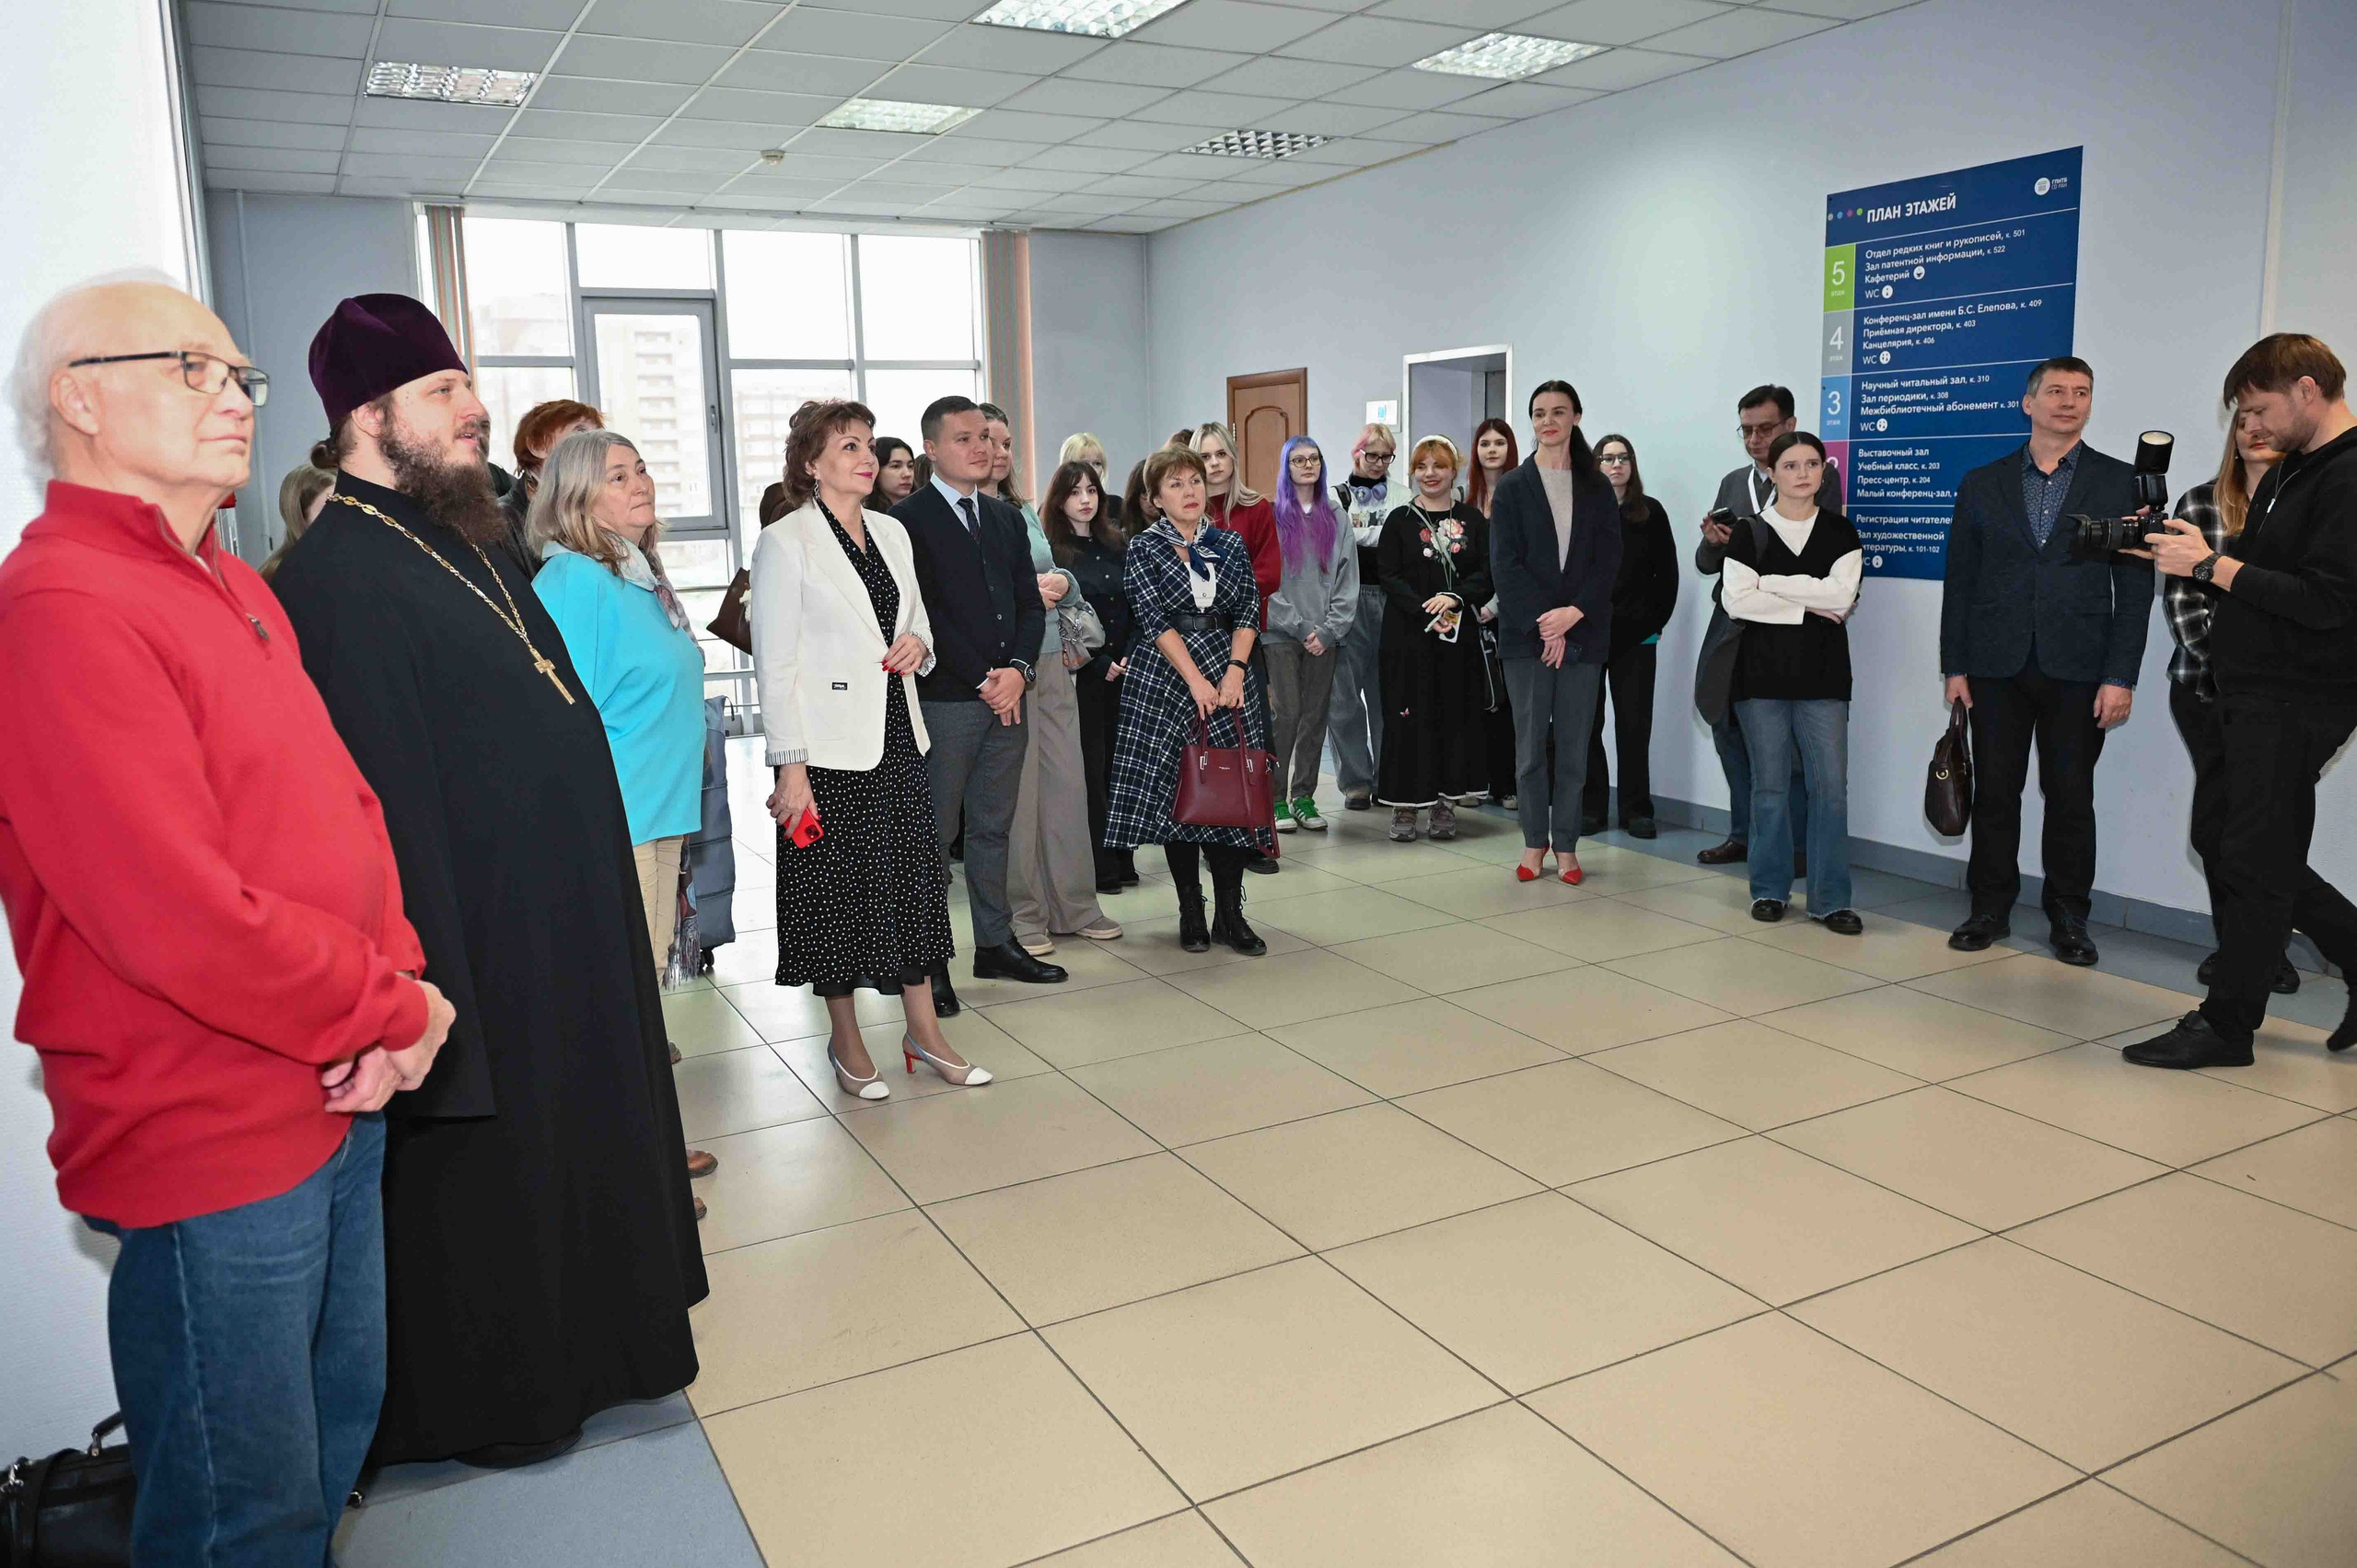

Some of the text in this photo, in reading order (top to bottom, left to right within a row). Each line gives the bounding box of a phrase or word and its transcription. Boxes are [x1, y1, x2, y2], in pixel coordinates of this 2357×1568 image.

[1867, 192, 1956, 224] ПЛАН ЭТАЖЕЙ
[1865, 249, 1891, 261] Отдел
[1893, 244, 1923, 258] редких
[1925, 241, 1944, 251] книг
[1954, 231, 2003, 249] рукописей,
[2013, 229, 2026, 238] 501
[1865, 262, 1880, 272] Зал
[1882, 256, 1924, 270] патентной
[1926, 247, 1985, 266] информации,
[1993, 246, 2005, 254] 522
[1832, 261, 1846, 285] 5
[1864, 270, 1910, 285] Кафетерий
[1865, 289, 1879, 298] WC
[1864, 311, 1927, 326] Конференц-зал
[1928, 308, 1956, 319] имени
[1958, 304, 1976, 316] Б.С.
[1978, 302, 2018, 314] Елепова,
[2028, 299, 2042, 308] 409
[1864, 326, 1905, 338] Приёмная
[1906, 322, 1954, 336] директора,
[1964, 319, 1976, 328] 403
[1829, 326, 1844, 351] 4
[1863, 338, 1914, 352] Канцелярия,
[1863, 355, 1877, 365] WC
[1862, 379, 1898, 391] Научный
[1900, 376, 1947, 388] читальный
[1950, 376, 1968, 386] зал,
[1978, 375, 1990, 383] 310
[1828, 390, 1841, 415] 3
[1862, 394, 1876, 403] Зал
[1878, 392, 1928, 404] периодики,
[1861, 402, 1945, 416] Межбиблиотечный
[1946, 401, 1998, 412] абонемент
[2007, 401, 2019, 409] 301
[1860, 422, 1875, 432] WC
[1858, 447, 1929, 458] Выставочный зал
[1857, 462, 1893, 471] Учебный
[1857, 475, 1910, 486] Пресс-центр,
[1857, 489, 1885, 498] Малый
[1887, 489, 1952, 499] конференц-зал,
[1856, 515, 1909, 525] Регистрация
[1857, 529, 1945, 541] Зал художественной
[1862, 544, 1907, 554] итературы,
